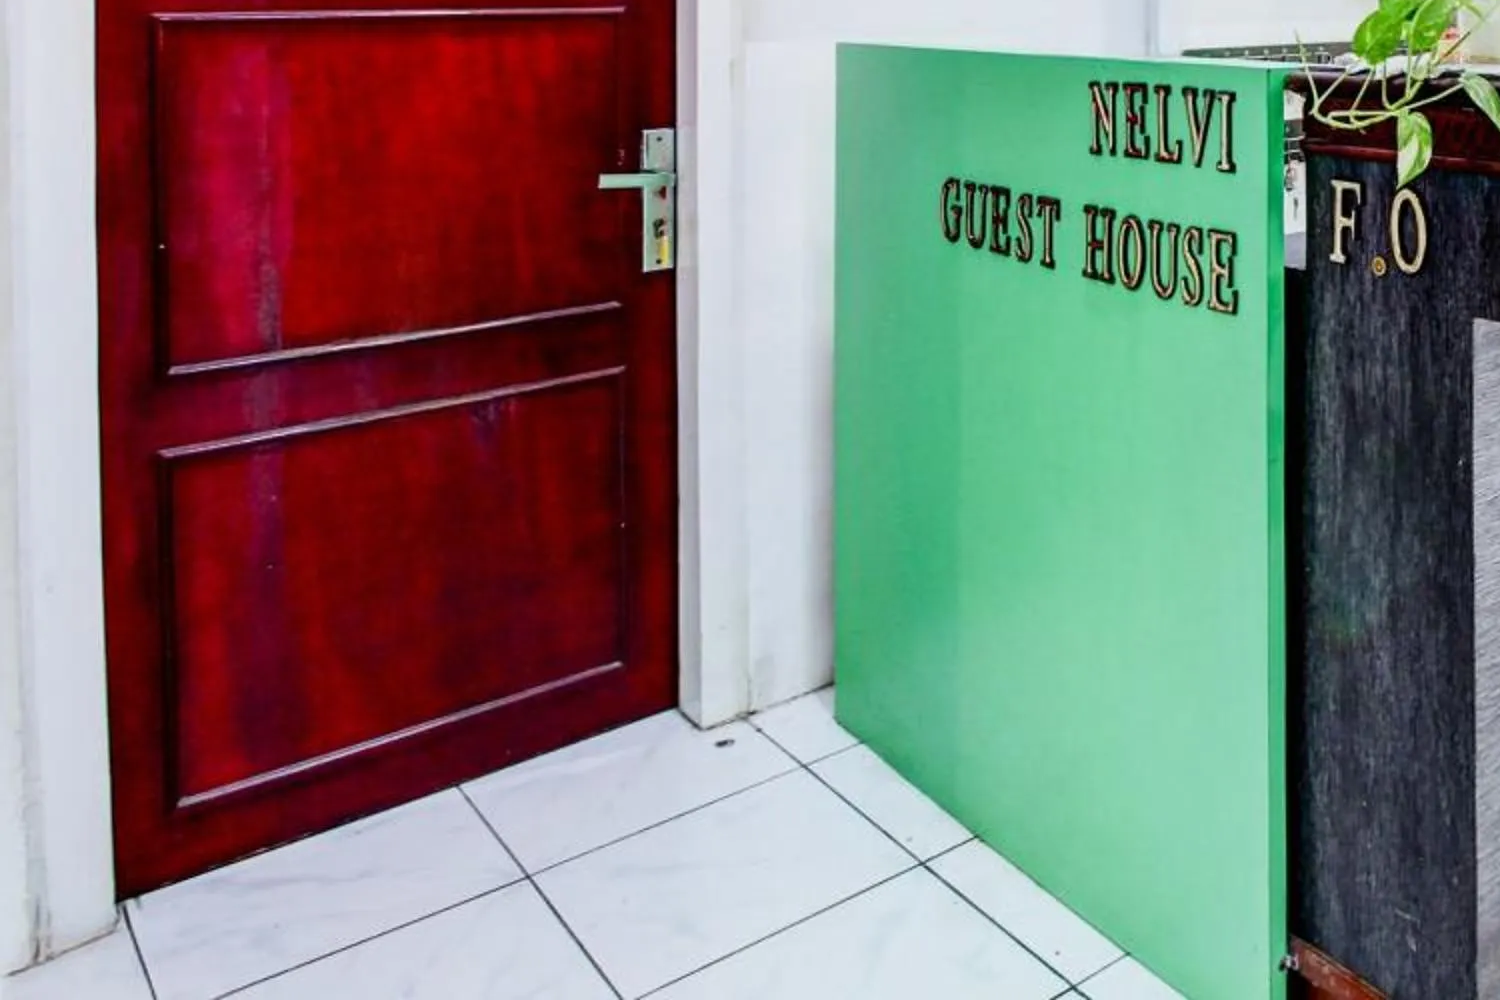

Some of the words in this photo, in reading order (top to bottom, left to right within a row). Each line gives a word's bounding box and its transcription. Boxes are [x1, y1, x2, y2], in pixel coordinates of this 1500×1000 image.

[1087, 80, 1238, 174] NELVI
[938, 176, 1062, 269] GUEST
[1081, 204, 1240, 315] HOUSE
